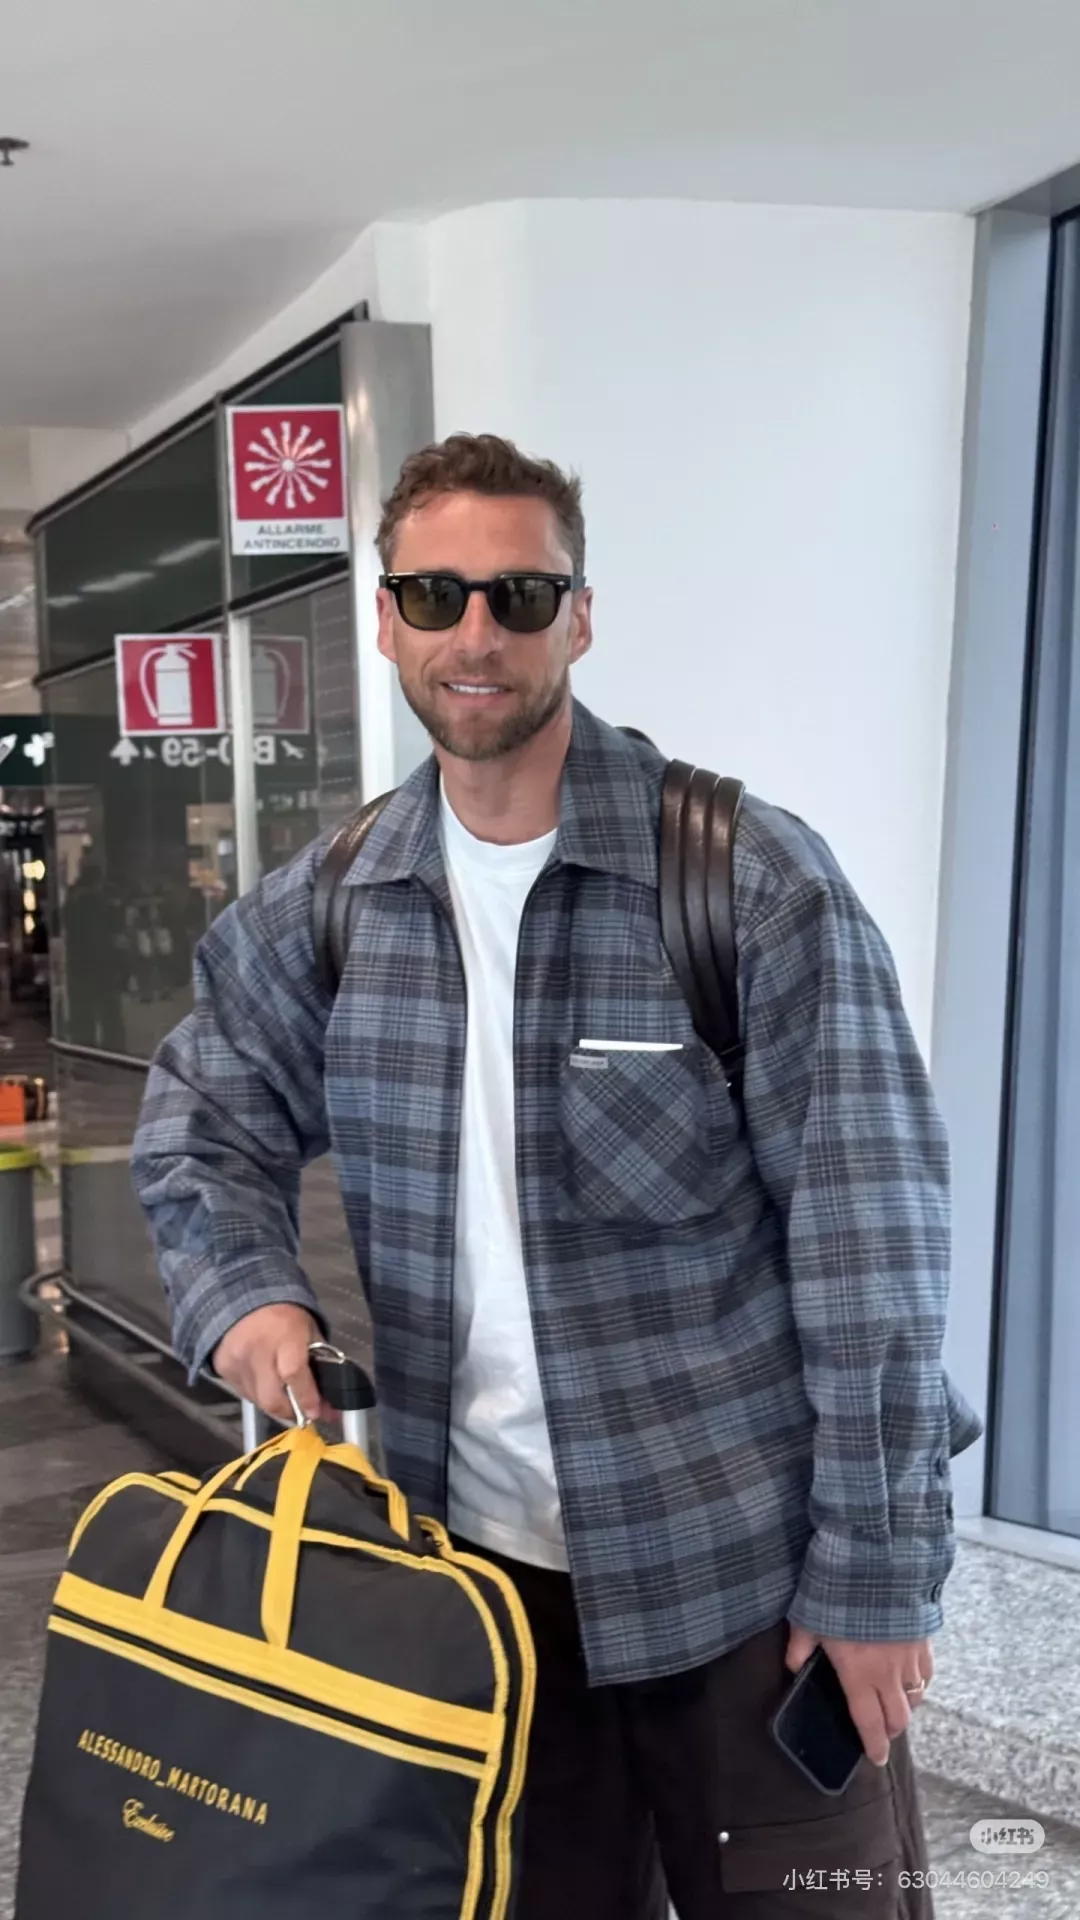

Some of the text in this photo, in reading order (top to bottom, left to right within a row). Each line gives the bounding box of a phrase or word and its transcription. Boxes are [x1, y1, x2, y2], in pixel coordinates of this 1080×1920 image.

[258, 524, 324, 535] ALLARME
[244, 538, 340, 550] ANTINCENDIO
[77, 1728, 269, 1825] ALESSANDRO_MARTORANA
